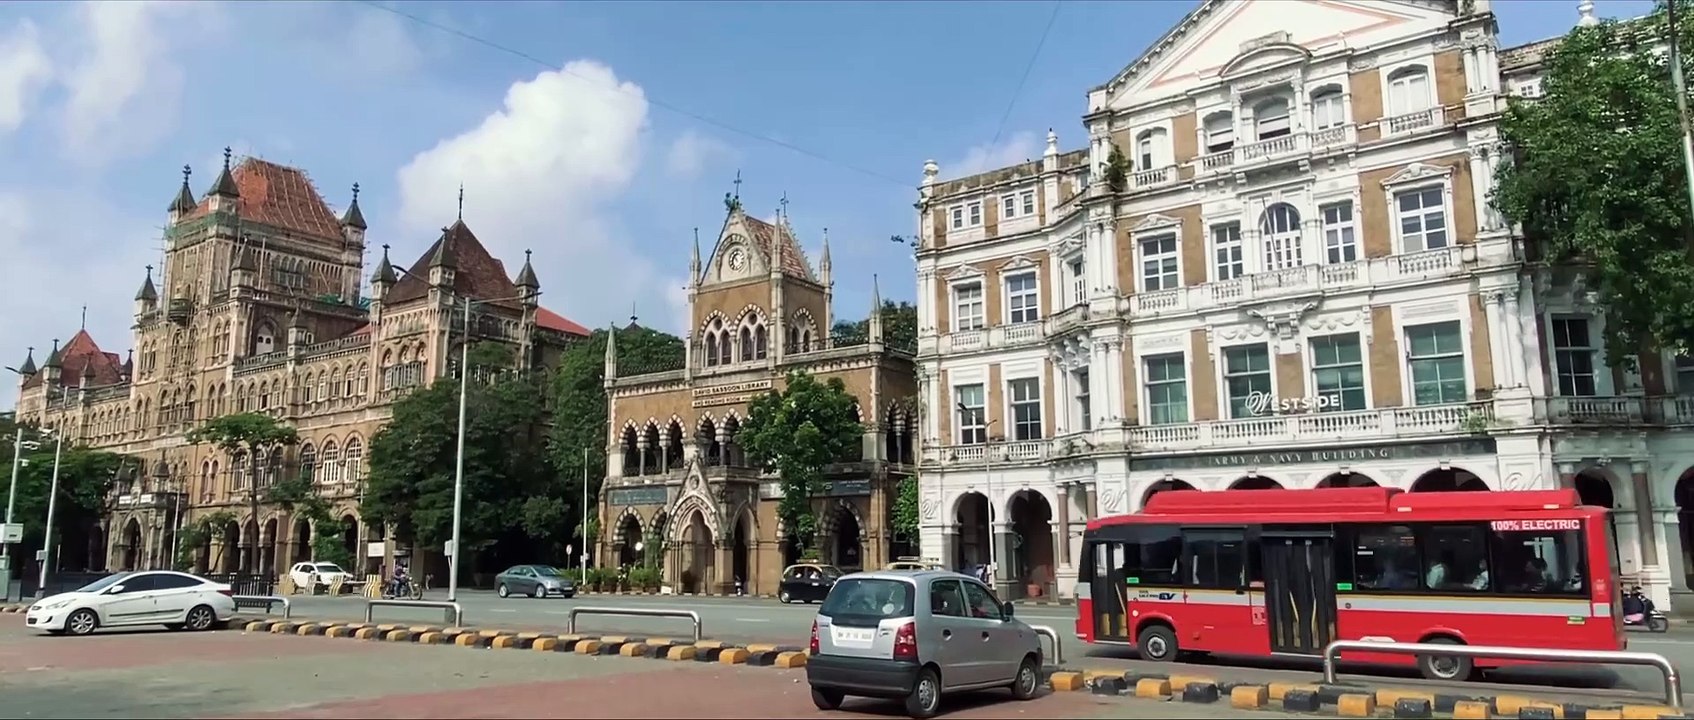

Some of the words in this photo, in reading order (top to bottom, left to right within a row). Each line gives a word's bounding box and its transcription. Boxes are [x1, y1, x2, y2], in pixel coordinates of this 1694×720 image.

[694, 388, 711, 396] DAVID
[712, 385, 740, 393] SASSOON
[741, 381, 769, 390] LIBRARY
[1245, 391, 1340, 416] WESTSIDE
[1213, 457, 1246, 465] ARMY
[1253, 455, 1261, 464] &
[1270, 453, 1302, 463] NAVY
[1311, 449, 1388, 461] BUILDING
[1491, 520, 1520, 531] 100%
[1521, 519, 1580, 530] ELECTRIC
